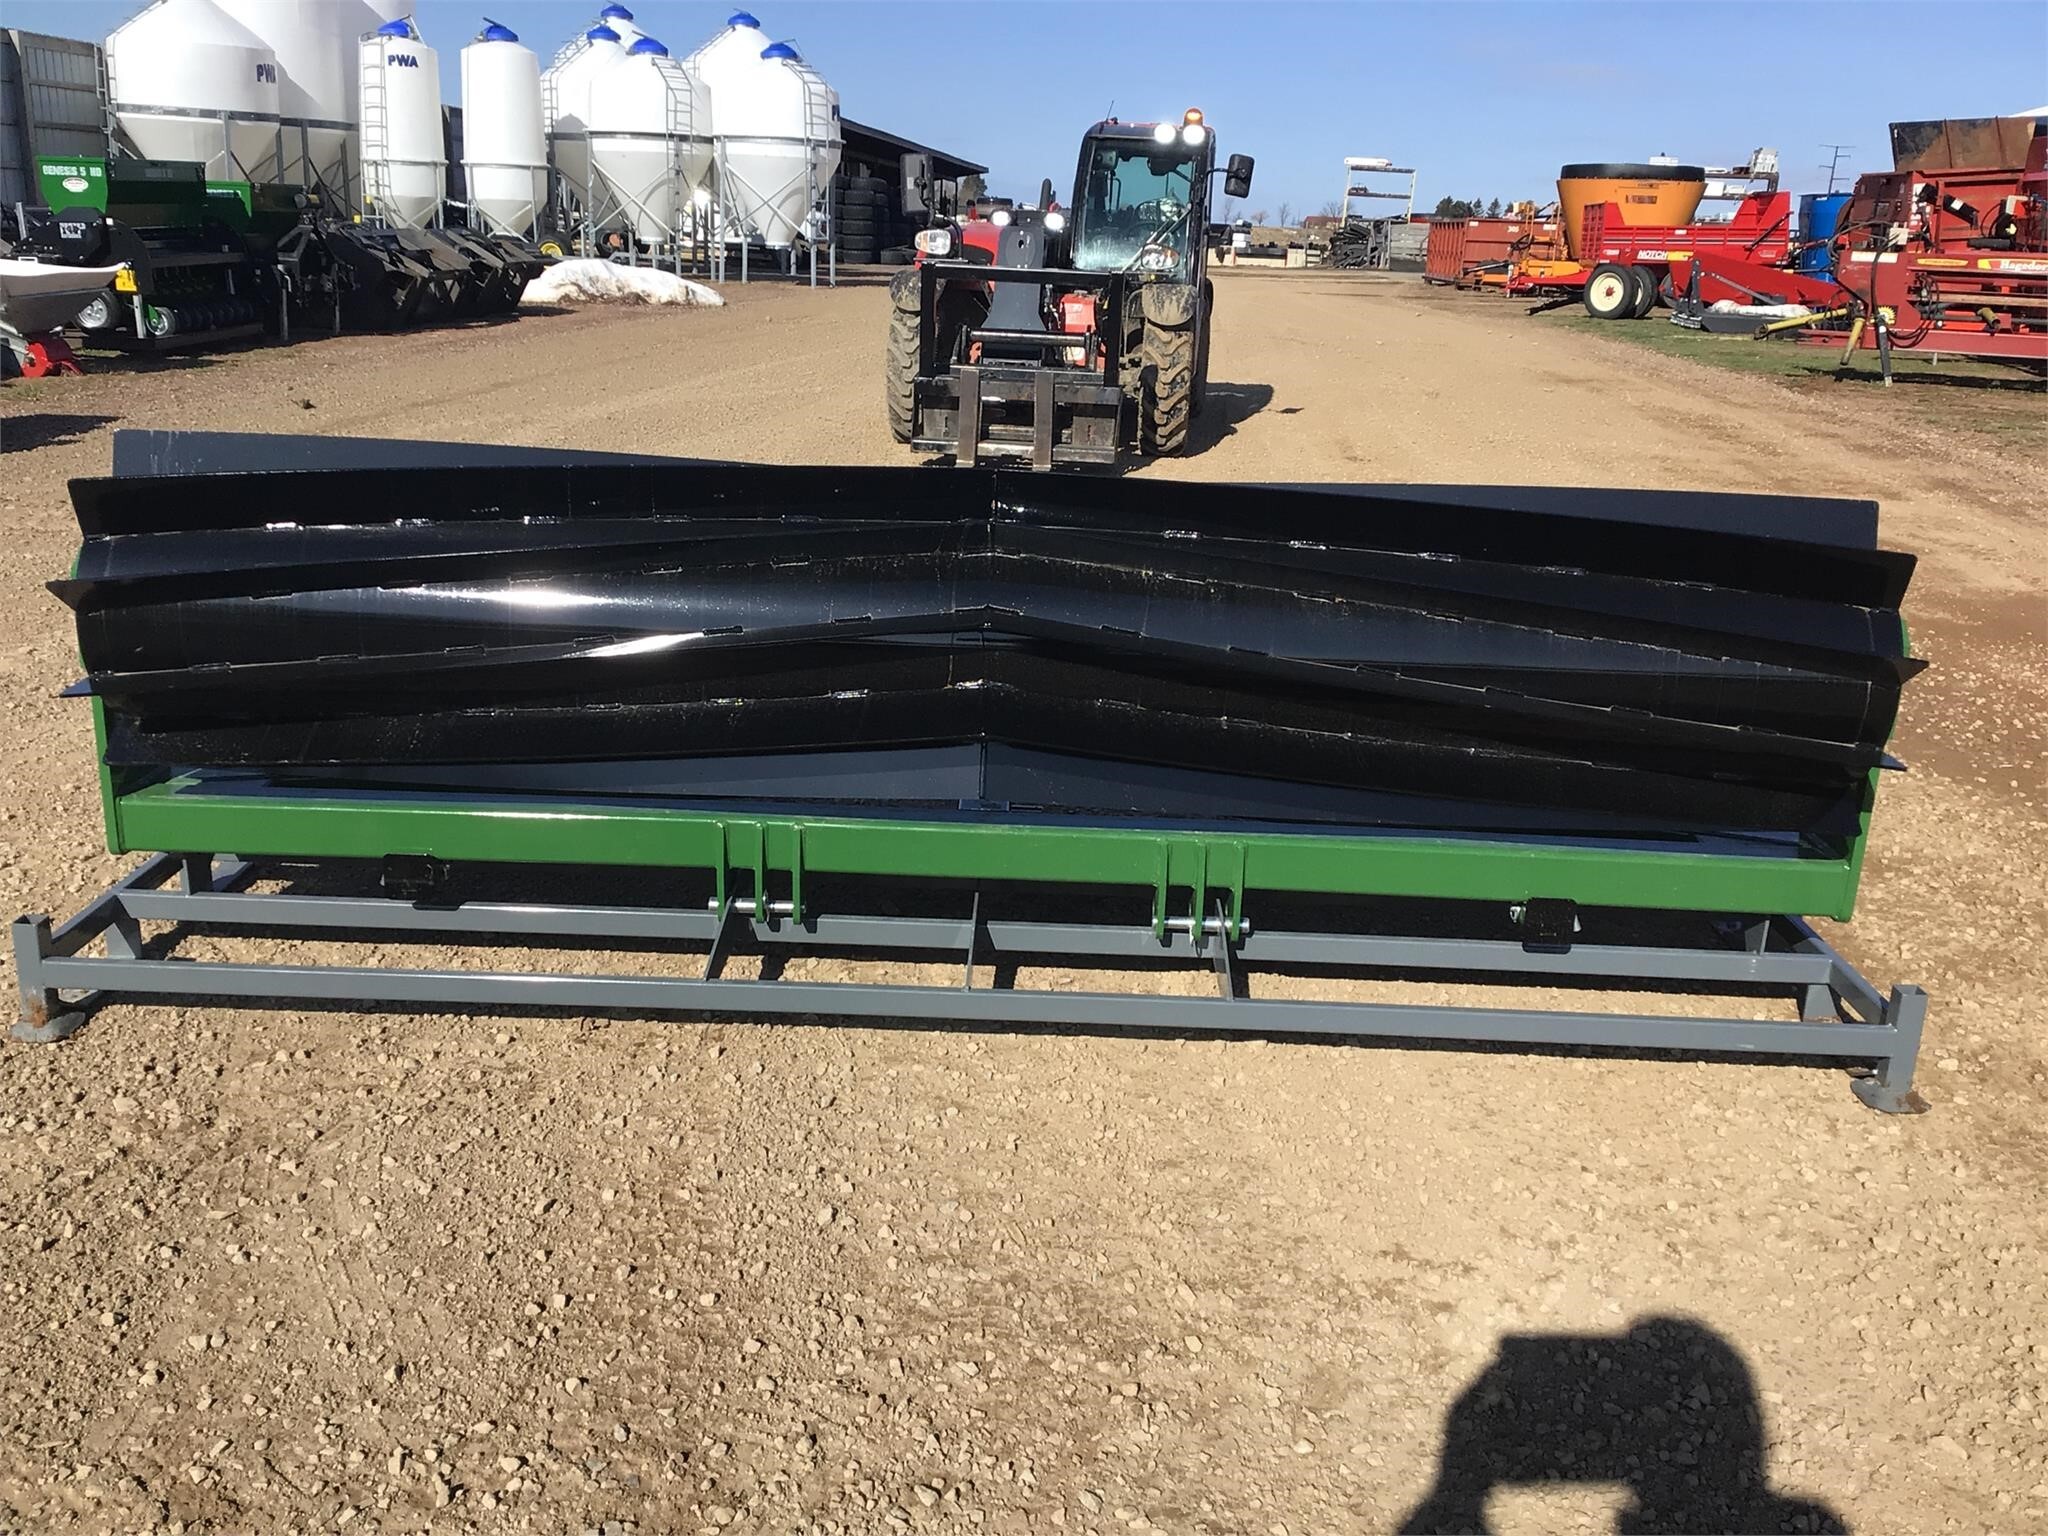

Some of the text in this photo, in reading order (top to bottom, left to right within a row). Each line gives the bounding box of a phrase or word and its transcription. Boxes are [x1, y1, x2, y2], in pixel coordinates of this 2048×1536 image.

[387, 54, 419, 68] PWA
[42, 165, 78, 176] GENESIS
[80, 167, 87, 176] 5
[1637, 249, 1668, 260] NOTCH
